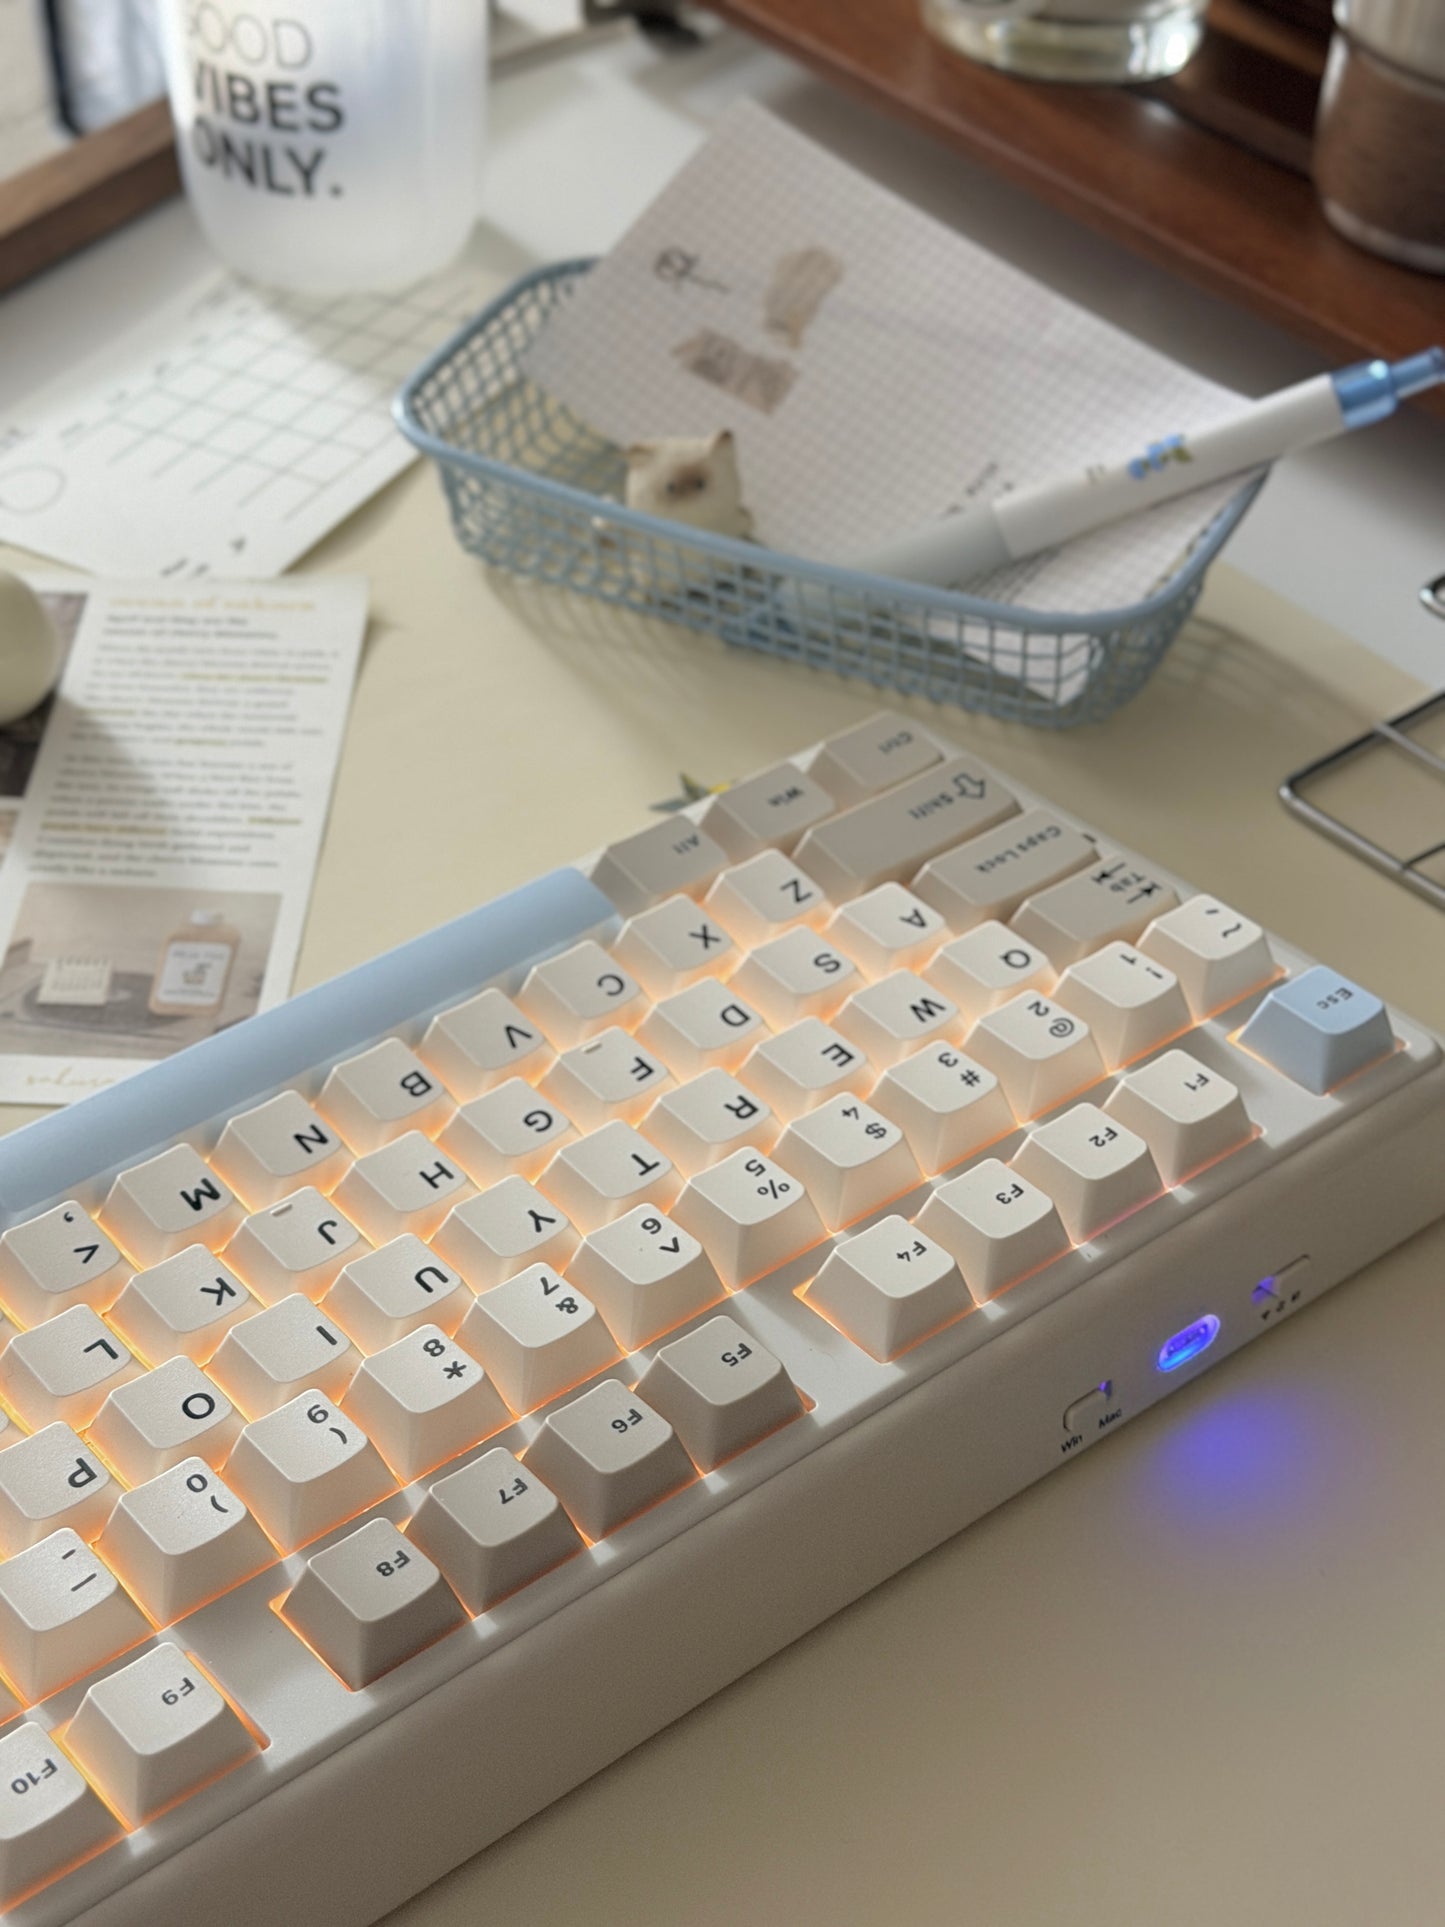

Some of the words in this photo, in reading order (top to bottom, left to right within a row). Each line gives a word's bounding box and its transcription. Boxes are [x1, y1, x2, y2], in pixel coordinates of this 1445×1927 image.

[189, 2, 314, 70] OOD
[191, 115, 344, 199] ONLY.
[877, 730, 914, 755] Ctrl
[908, 791, 955, 820] Shift
[1014, 824, 1063, 855] Caps
[974, 848, 1017, 874] Lock
[780, 879, 813, 903] Z
[899, 908, 927, 929] A
[689, 924, 721, 950] X
[813, 952, 842, 974] S
[999, 949, 1032, 969] Q
[596, 973, 625, 997] C
[720, 1004, 751, 1028] D
[909, 997, 946, 1023] W
[1027, 1000, 1050, 1017] 2
[504, 1024, 533, 1049] V
[1048, 1017, 1075, 1039] @
[821, 1043, 855, 1068] E
[937, 1052, 959, 1068] 3
[630, 1056, 655, 1082] F
[400, 1070, 433, 1098] B
[1184, 1072, 1210, 1092] F1
[724, 1095, 759, 1120] R
[522, 1109, 553, 1133] G
[293, 1124, 329, 1154] N
[1088, 1126, 1119, 1148] F2
[418, 1161, 455, 1190] H
[631, 1153, 660, 1177] T
[744, 1159, 767, 1177] 5
[179, 1178, 221, 1212] M
[756, 1179, 791, 1200] %
[995, 1183, 1025, 1205] F3
[317, 1220, 338, 1246] J
[527, 1209, 557, 1233] Y
[640, 1217, 662, 1235] 6
[896, 1240, 927, 1262] F4
[199, 1276, 237, 1307] K
[414, 1266, 449, 1294] U
[539, 1276, 560, 1296] 7
[83, 1338, 119, 1360] L
[422, 1338, 446, 1358] 8
[720, 1342, 753, 1367] F5
[181, 1392, 216, 1420] O
[306, 1404, 329, 1424] 9
[611, 1408, 644, 1434] F6
[67, 1457, 98, 1489] P
[185, 1473, 209, 1493] 0
[498, 1477, 529, 1505] F7
[375, 1550, 411, 1577] F8
[161, 1677, 196, 1706] F9
[10, 1758, 58, 1795] F10
